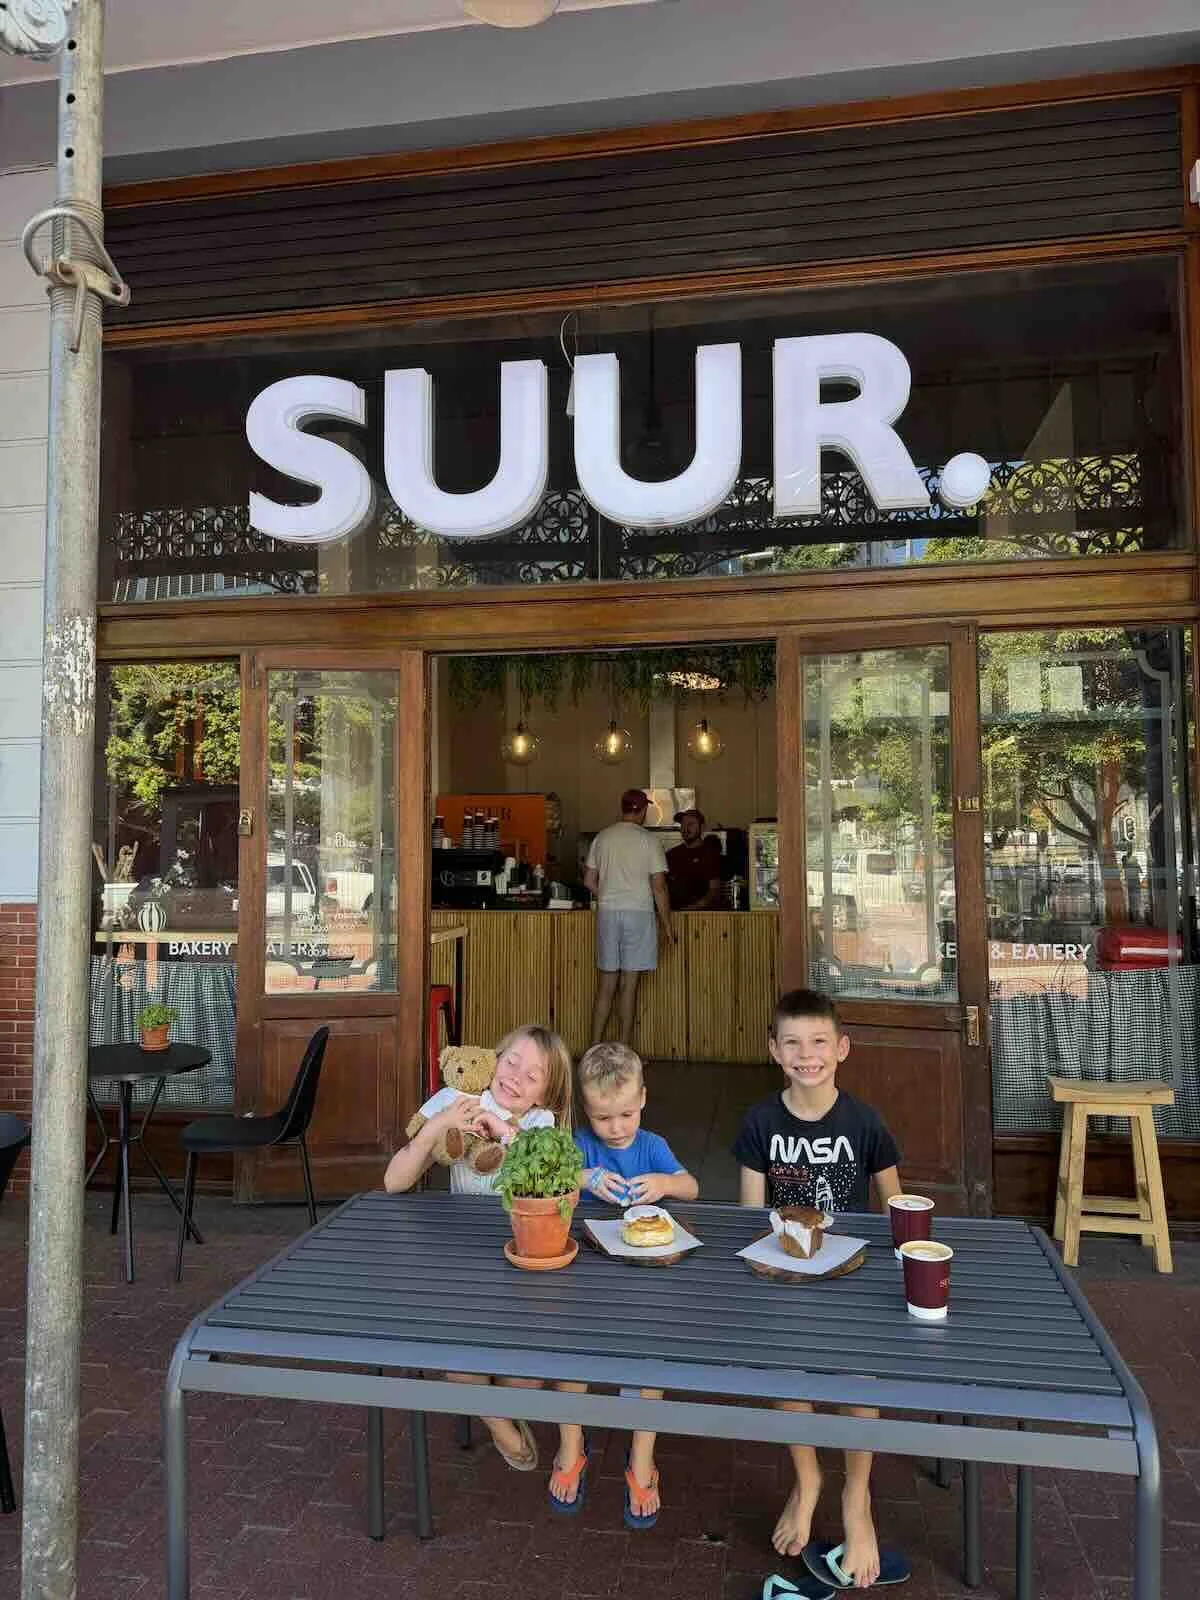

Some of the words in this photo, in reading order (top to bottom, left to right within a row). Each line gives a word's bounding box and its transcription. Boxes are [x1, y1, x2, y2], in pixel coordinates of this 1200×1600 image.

[245, 333, 992, 545] SUUR.
[168, 941, 233, 957] BAKERY
[1012, 943, 1091, 961] EATERY
[769, 1134, 854, 1164] NASA
